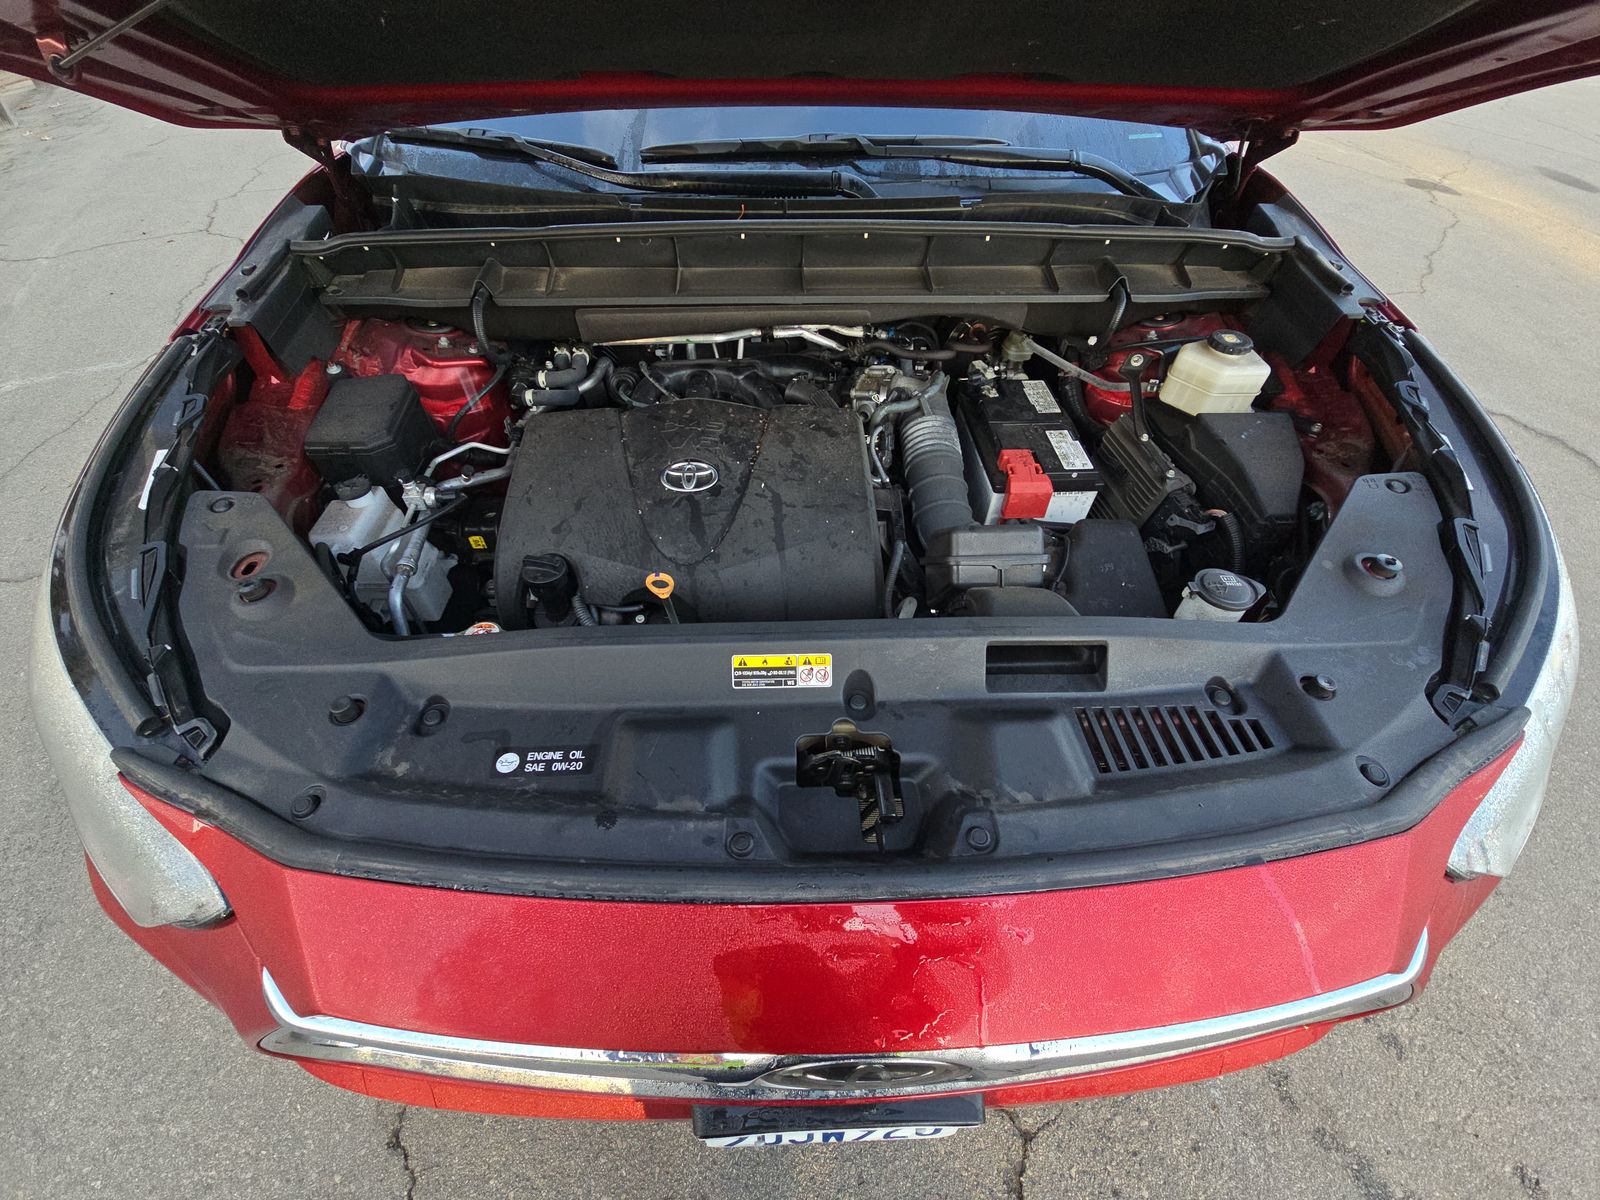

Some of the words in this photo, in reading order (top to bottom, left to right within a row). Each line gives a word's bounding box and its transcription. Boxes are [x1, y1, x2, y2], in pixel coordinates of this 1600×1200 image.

[527, 751, 564, 760] ENGINE
[569, 750, 585, 759] OIL
[524, 763, 545, 772] SAE
[552, 762, 583, 771] 0W-20
